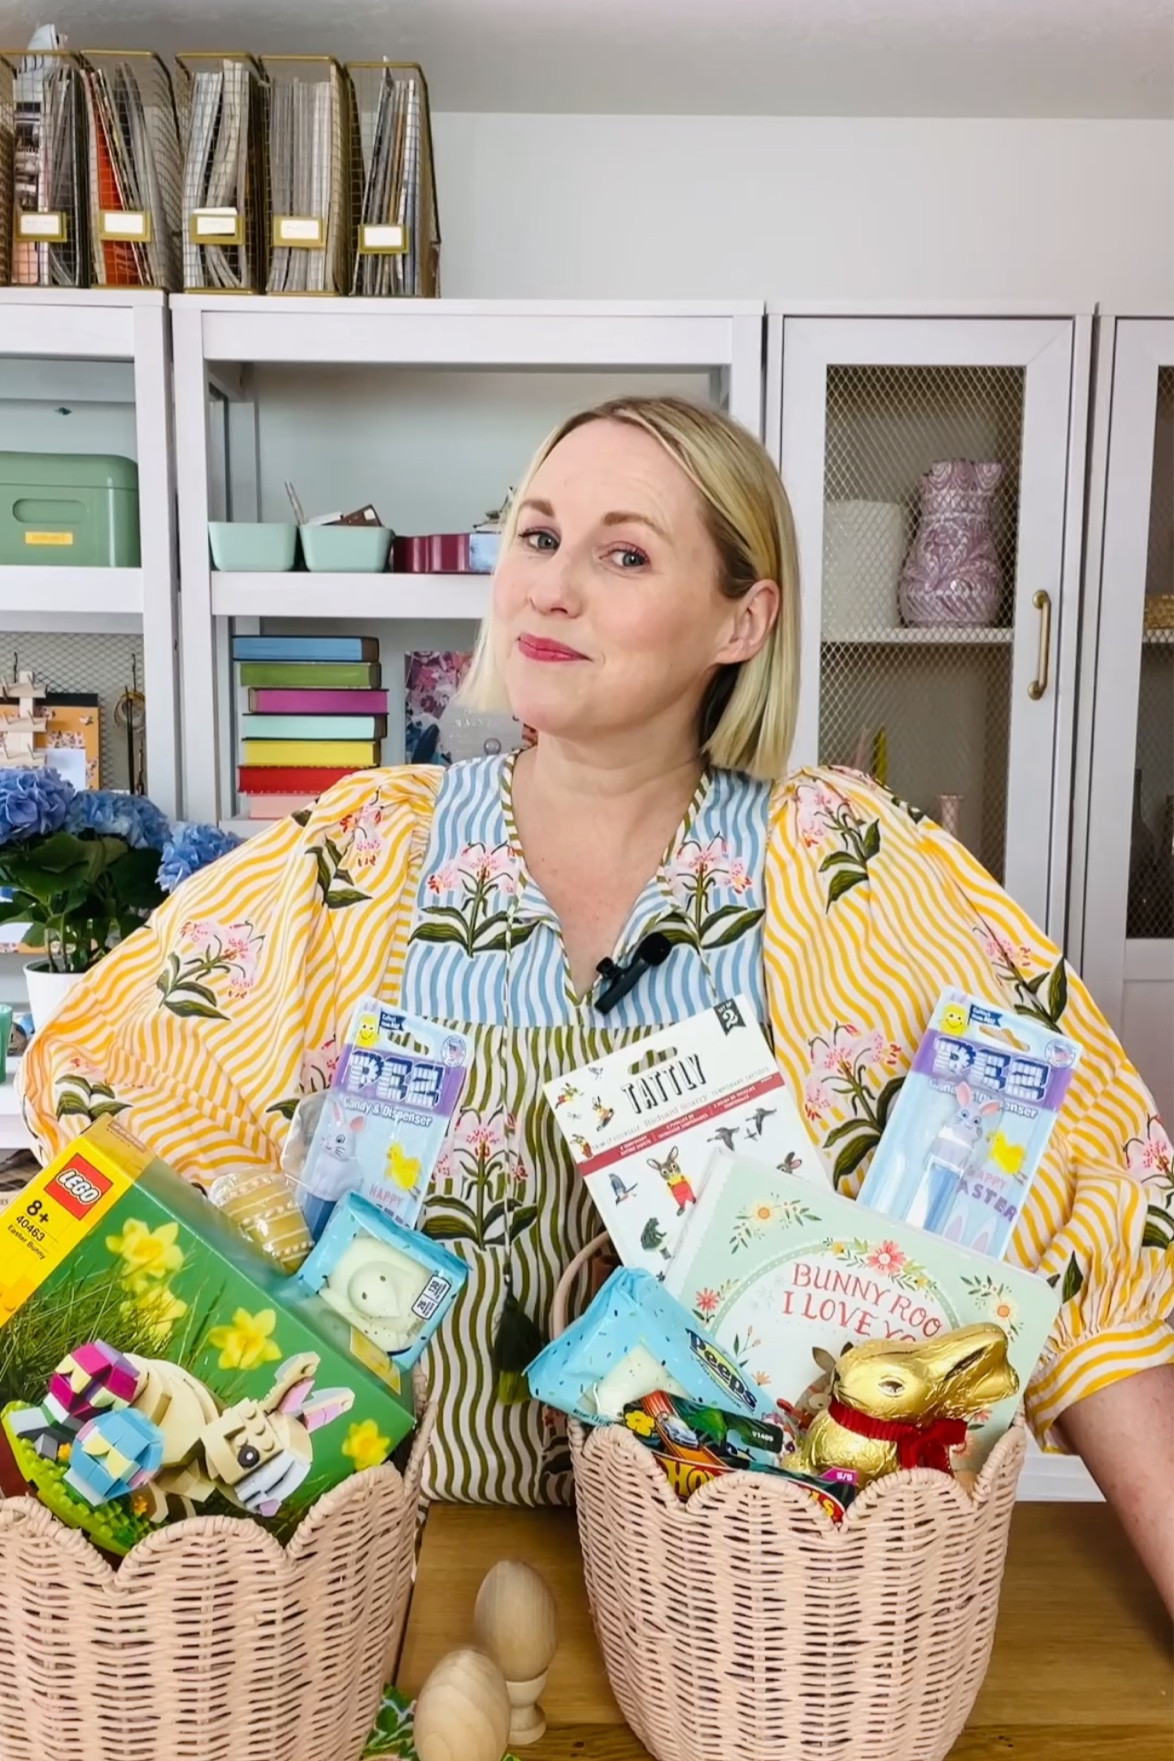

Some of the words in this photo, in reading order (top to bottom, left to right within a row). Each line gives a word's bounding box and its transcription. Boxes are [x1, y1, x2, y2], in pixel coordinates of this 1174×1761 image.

[345, 1048, 446, 1109] PEZ
[621, 1053, 707, 1114] TATTLY
[932, 1036, 1051, 1103] PEZ
[56, 1168, 102, 1205] LEGO
[369, 1184, 404, 1207] HAPPY
[956, 1178, 1018, 1222] ASTER
[16, 1215, 46, 1242] 40463
[27, 1200, 49, 1223] 8+
[7, 1224, 27, 1243] Easter
[27, 1240, 46, 1260] Bunny
[782, 1290, 795, 1315] I
[802, 1292, 879, 1337] LOVE
[792, 1262, 891, 1307] BUNNY
[889, 1294, 942, 1338] ROO
[661, 1457, 716, 1500] HO
